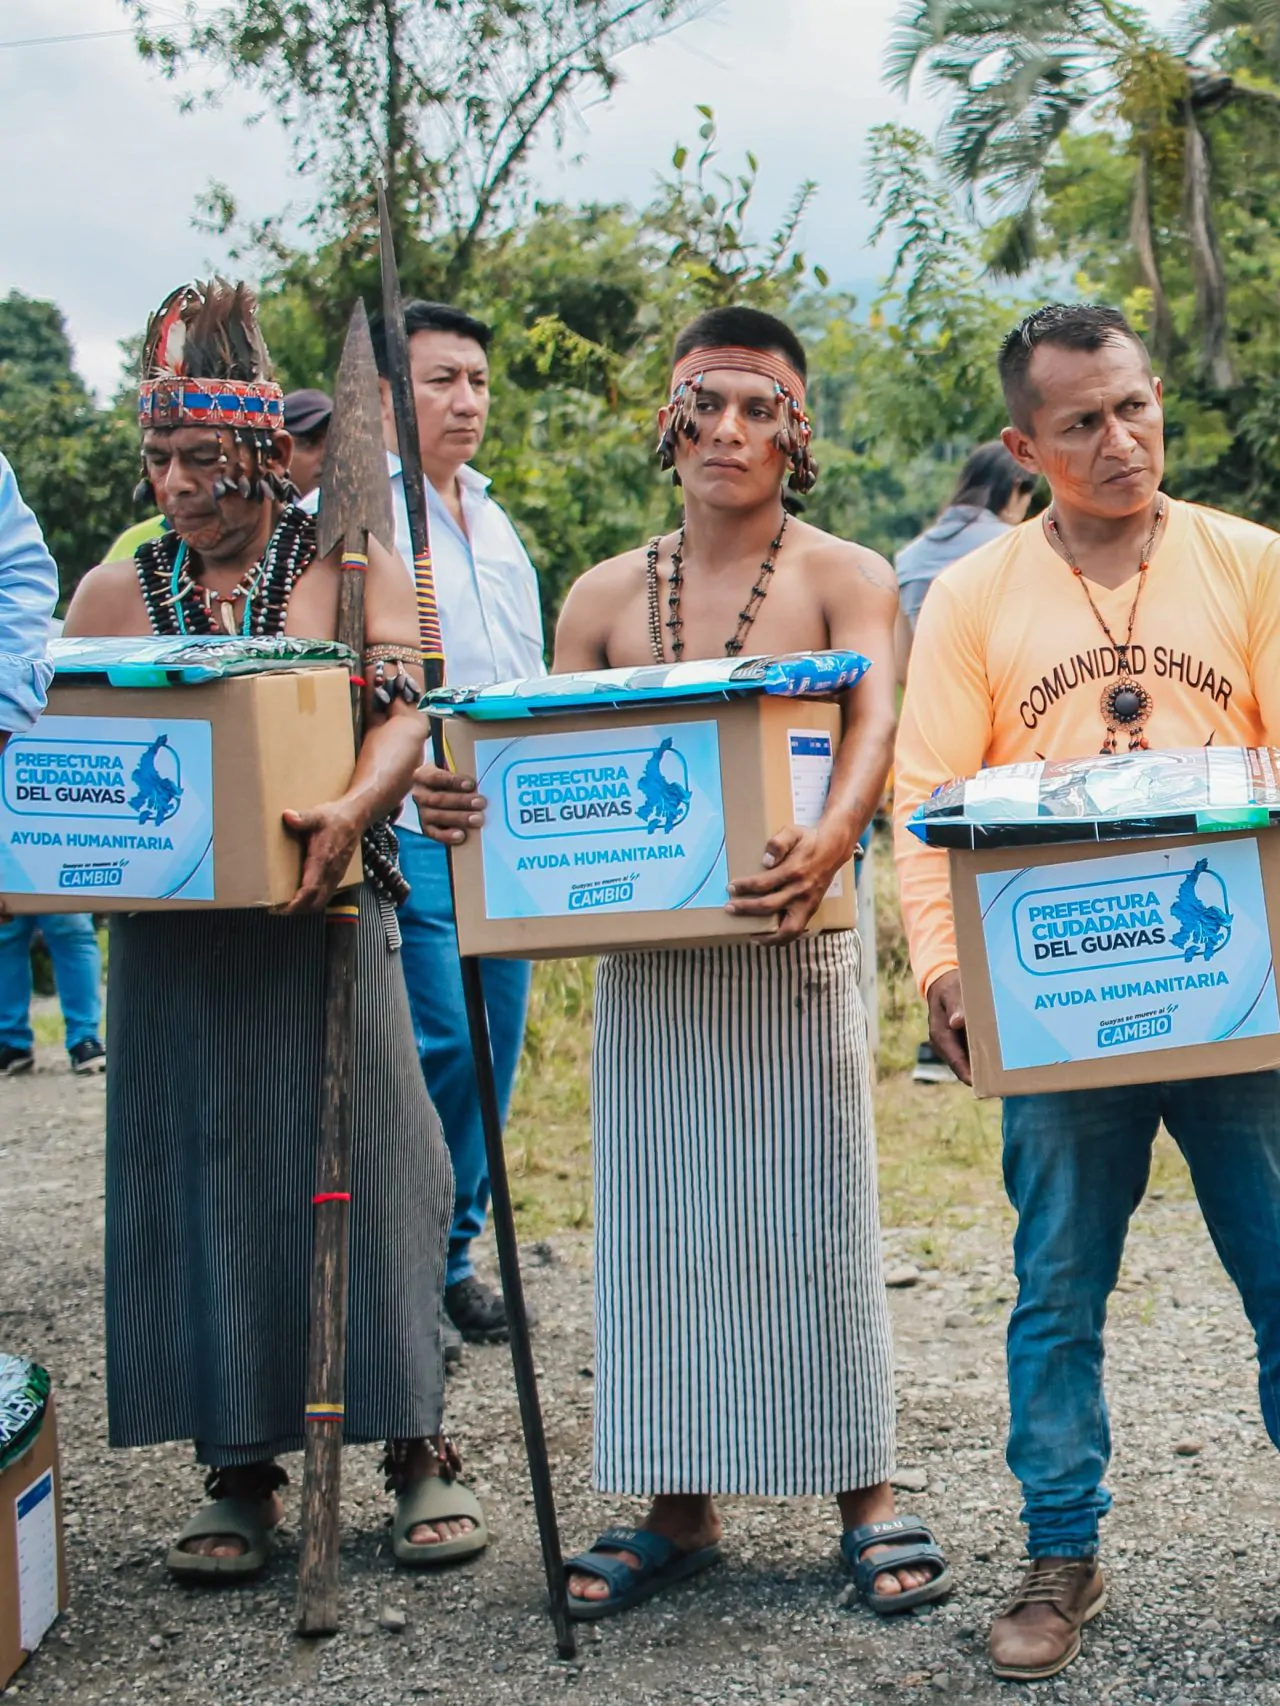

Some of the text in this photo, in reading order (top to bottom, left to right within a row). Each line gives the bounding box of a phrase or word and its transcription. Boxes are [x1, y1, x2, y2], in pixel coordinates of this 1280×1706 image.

[1019, 645, 1233, 730] COMUNIDAD SHUAR
[15, 753, 124, 769] PREFECTURA
[16, 768, 125, 787] CIUDADANA
[516, 766, 629, 789] PREFECTURA
[16, 786, 126, 804] DEL GUAYAS
[518, 782, 632, 807] CIUDADANA
[520, 800, 633, 824] DEL GUAYAS
[10, 831, 174, 850] AYUDA HUMANITARIA
[516, 844, 686, 871] AYUDA HUMANITARIA
[62, 870, 120, 886] CAMBIO
[571, 885, 631, 907] CAMBIO
[1028, 891, 1160, 922] PREFECTURA
[1031, 909, 1164, 941] CIUDADANA
[1034, 928, 1166, 960] DEL GUAYAS
[1034, 971, 1229, 1010] AYUDA HUMANITARIA
[1099, 1017, 1124, 1027] Guayas
[1135, 1010, 1157, 1019] mueve
[1101, 1017, 1169, 1045] CAMBIO
